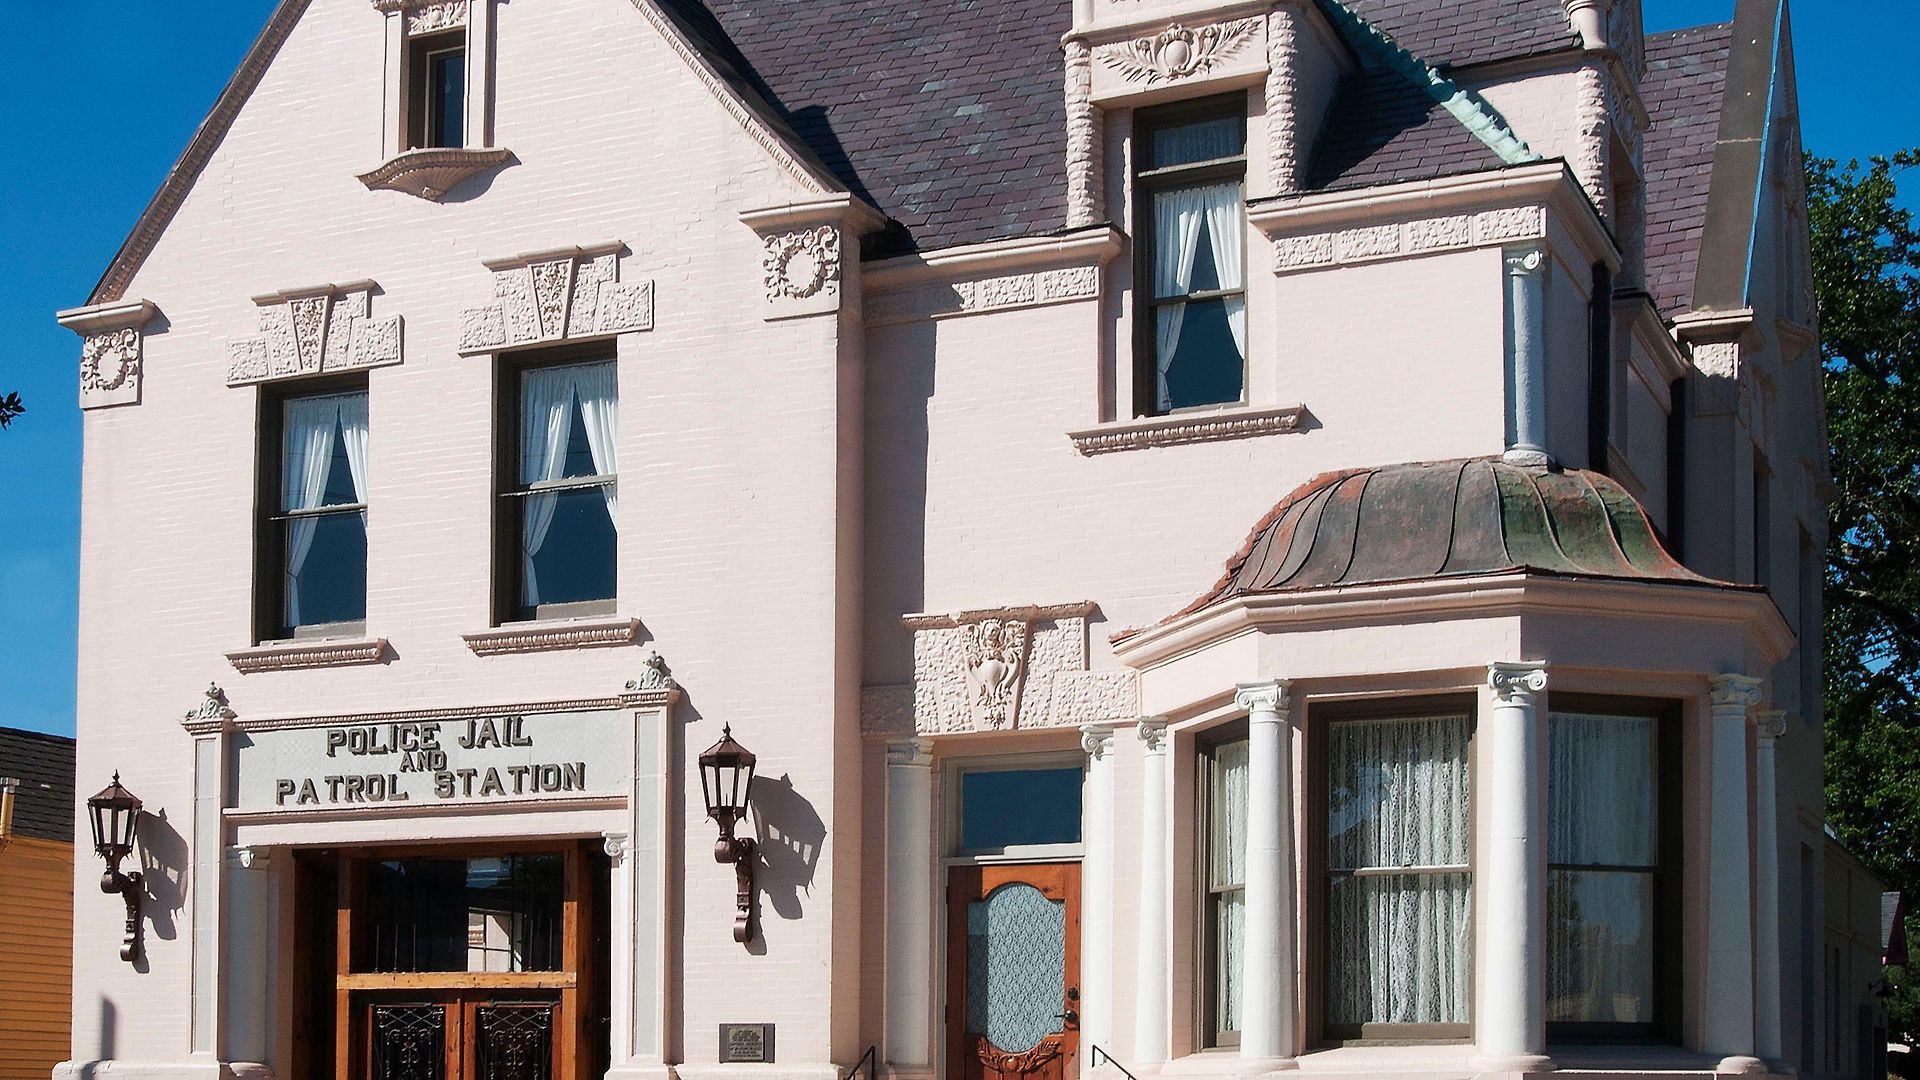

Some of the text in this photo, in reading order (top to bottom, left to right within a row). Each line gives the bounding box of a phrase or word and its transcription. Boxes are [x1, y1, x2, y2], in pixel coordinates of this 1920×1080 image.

[326, 716, 533, 757] POLICE JAIL
[400, 751, 448, 773] AND
[275, 761, 586, 806] PATROL STATION
